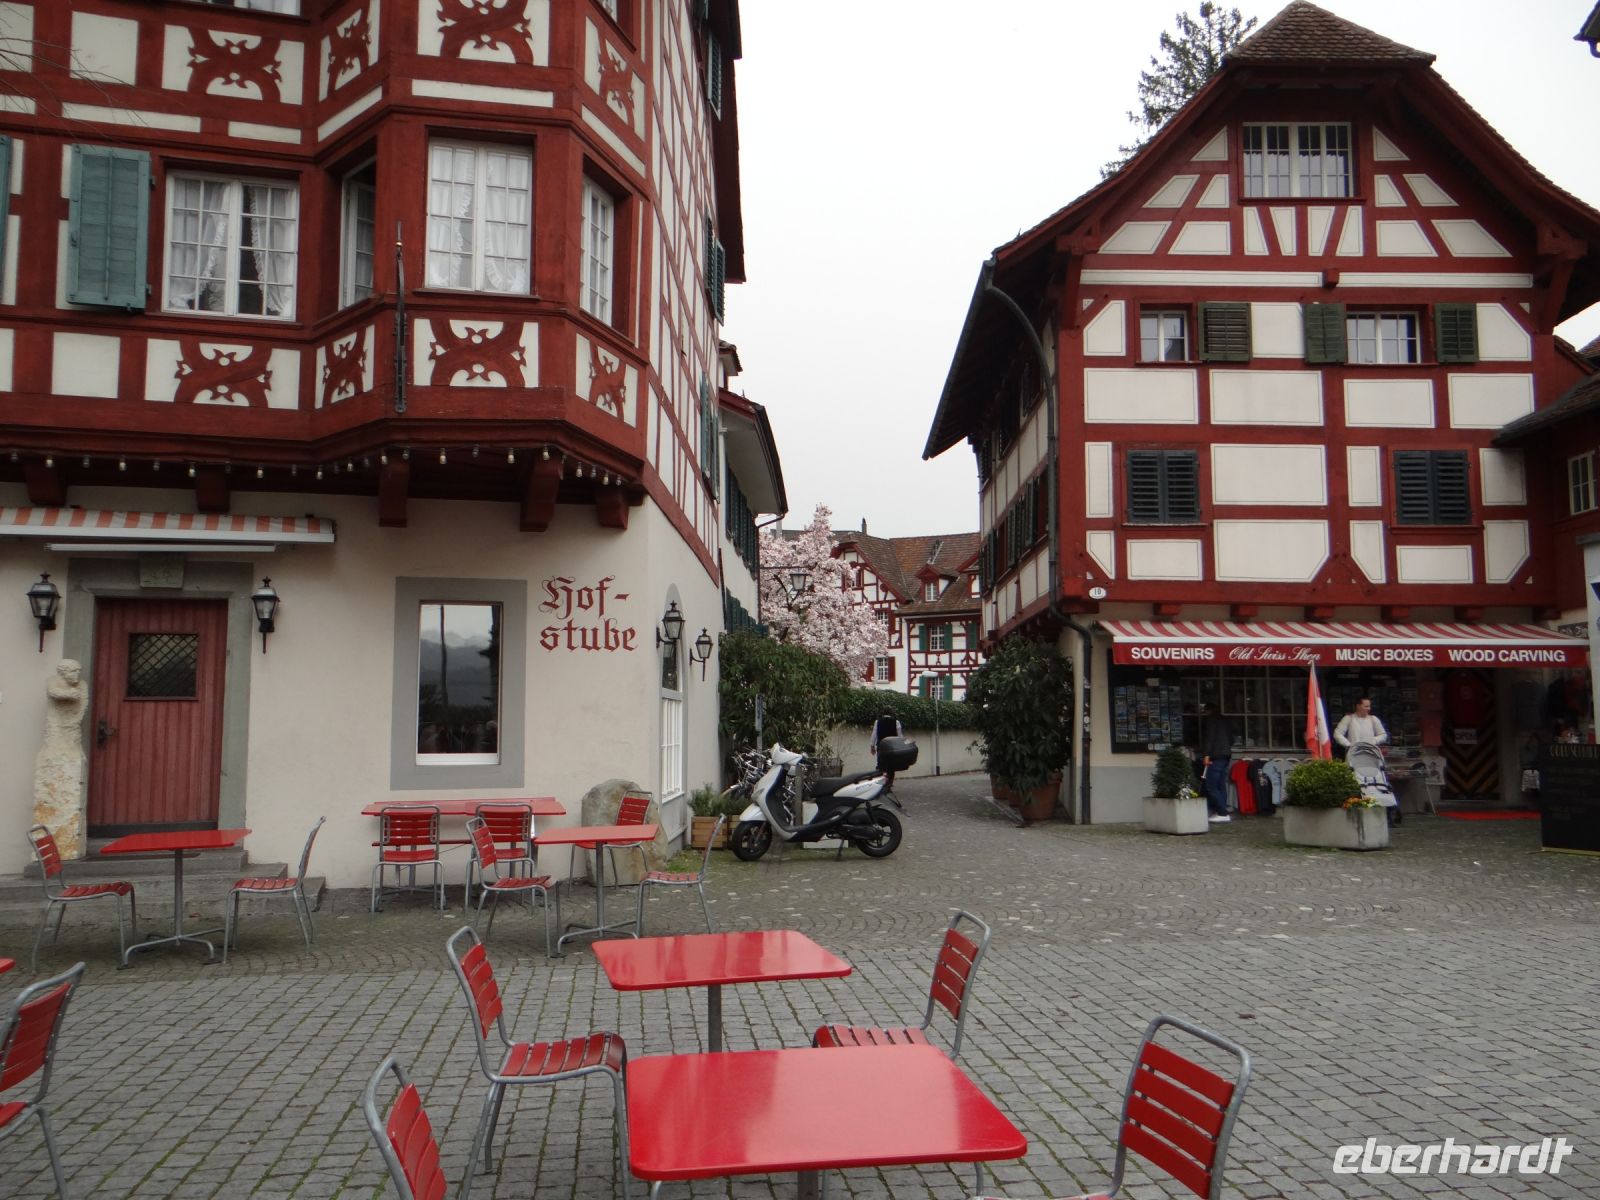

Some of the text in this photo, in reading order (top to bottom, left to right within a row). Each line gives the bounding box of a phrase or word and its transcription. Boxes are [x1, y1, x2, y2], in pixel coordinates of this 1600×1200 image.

[538, 574, 631, 620] Hof-
[540, 618, 638, 652] stube
[1131, 647, 1215, 660] SOUVENIRS
[1229, 646, 1255, 660] Old
[1254, 646, 1287, 660] Swiss
[1335, 648, 1381, 661] MUSIC
[1383, 648, 1434, 661] BOXES
[1448, 649, 1495, 662] WOOD
[1499, 649, 1566, 663] CARVING
